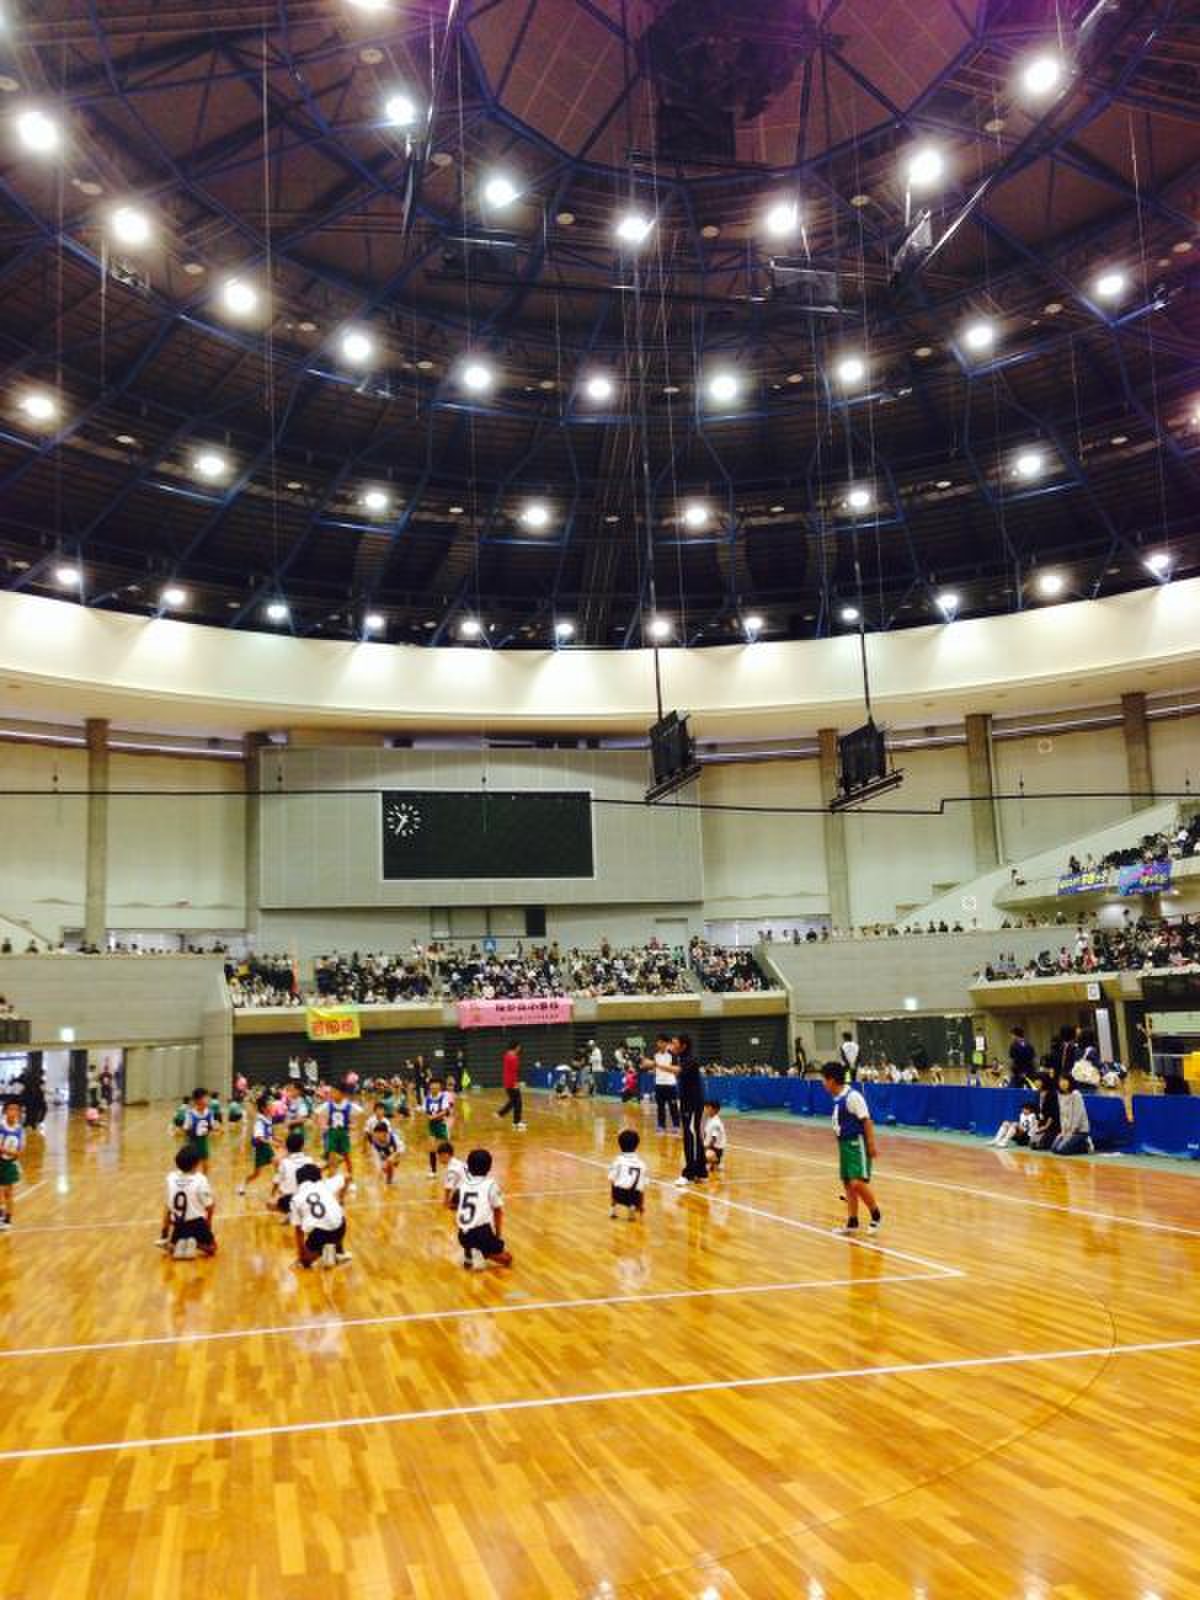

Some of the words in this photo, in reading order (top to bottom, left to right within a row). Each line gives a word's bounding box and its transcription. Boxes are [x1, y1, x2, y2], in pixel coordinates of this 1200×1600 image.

[628, 1166, 641, 1189] 7
[174, 1190, 188, 1219] 9
[306, 1192, 327, 1219] 8
[459, 1192, 479, 1226] 5
